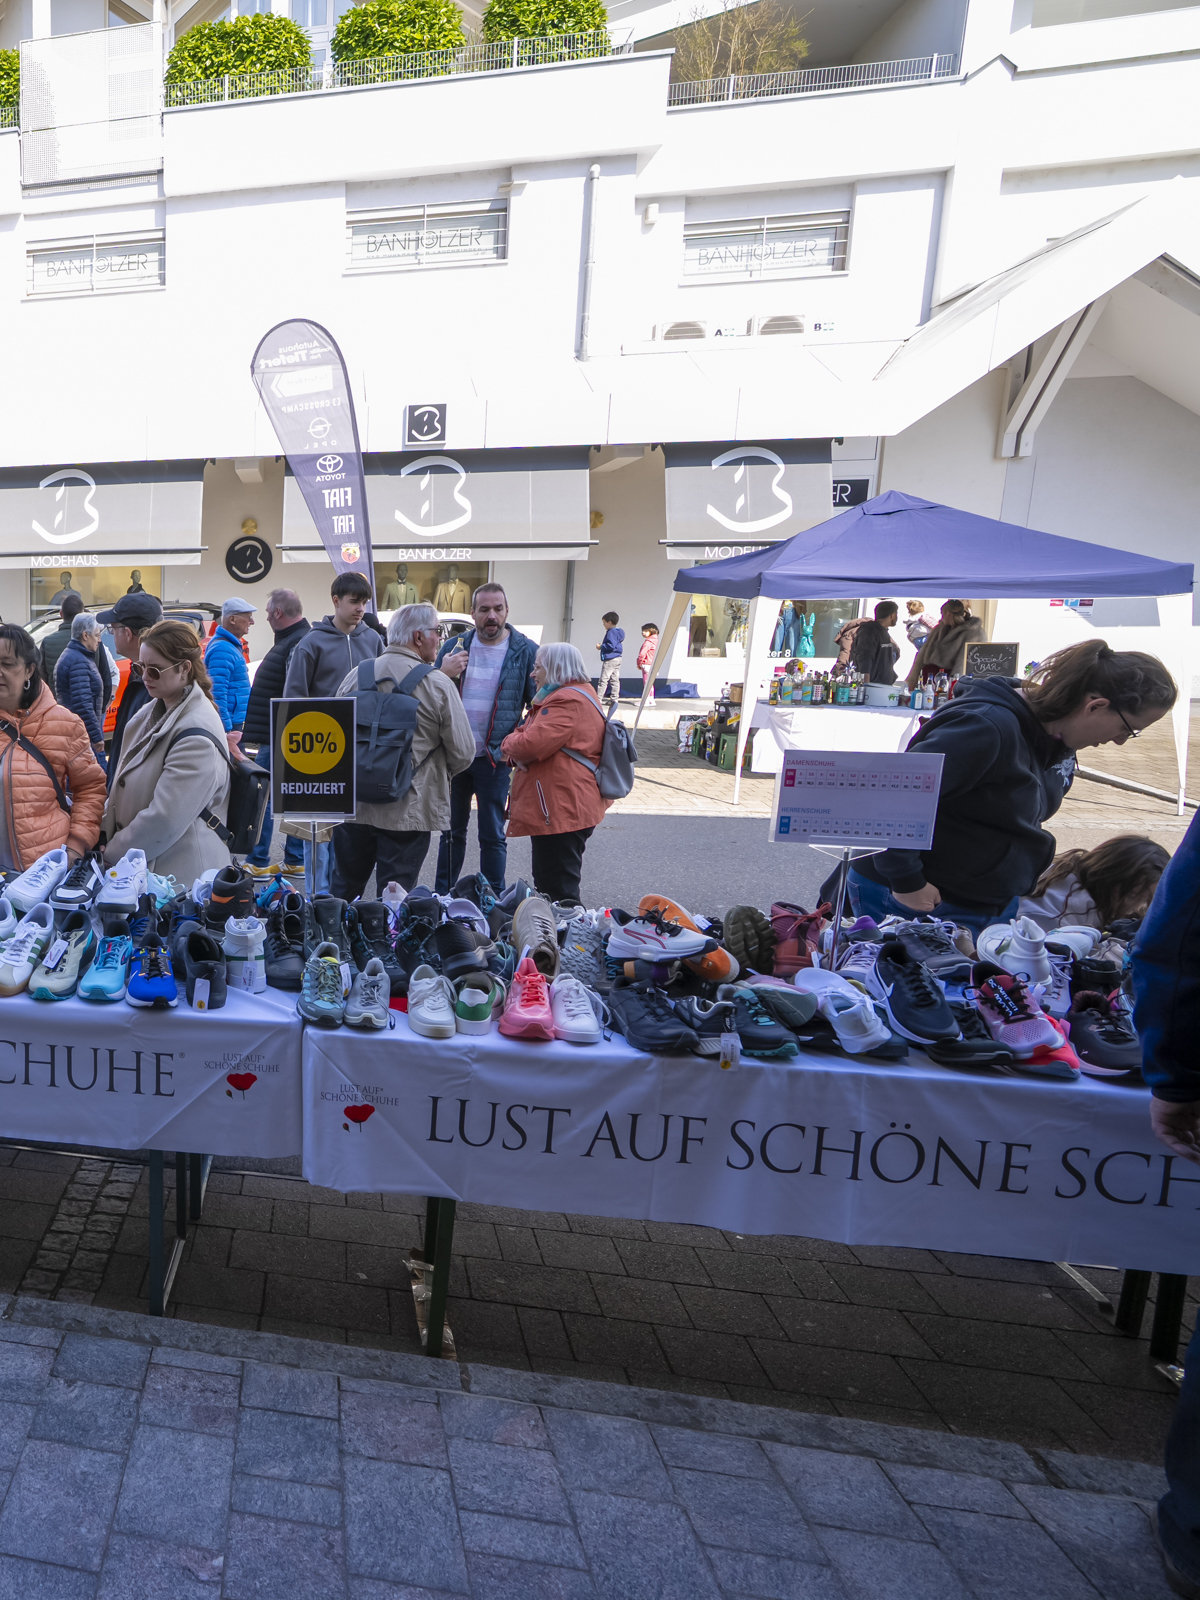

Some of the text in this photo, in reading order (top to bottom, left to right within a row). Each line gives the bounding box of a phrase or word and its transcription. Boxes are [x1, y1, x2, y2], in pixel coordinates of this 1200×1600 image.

[367, 228, 482, 253] BANHOLZER
[699, 239, 817, 265] BANHOLZER
[47, 253, 148, 277] BANHOLZER
[30, 554, 99, 567] MODEHAUS
[398, 548, 472, 560] BANHOLZER
[784, 648, 791, 658] 8
[288, 731, 338, 754] 50%
[786, 759, 836, 767] DAMENSCHUHE
[280, 782, 346, 795] REDUZIERT
[781, 807, 832, 815] HERRENSCHUHE
[222, 1052, 243, 1062] LUST
[204, 1059, 280, 1073] SCHÖNE SCHUHE
[339, 1083, 361, 1093] LUST
[320, 1090, 399, 1107] SCHÖNE SCHUHE
[425, 1095, 572, 1155] LUST
[580, 1110, 708, 1165] AUF
[726, 1121, 1033, 1195] SCHÖNE
